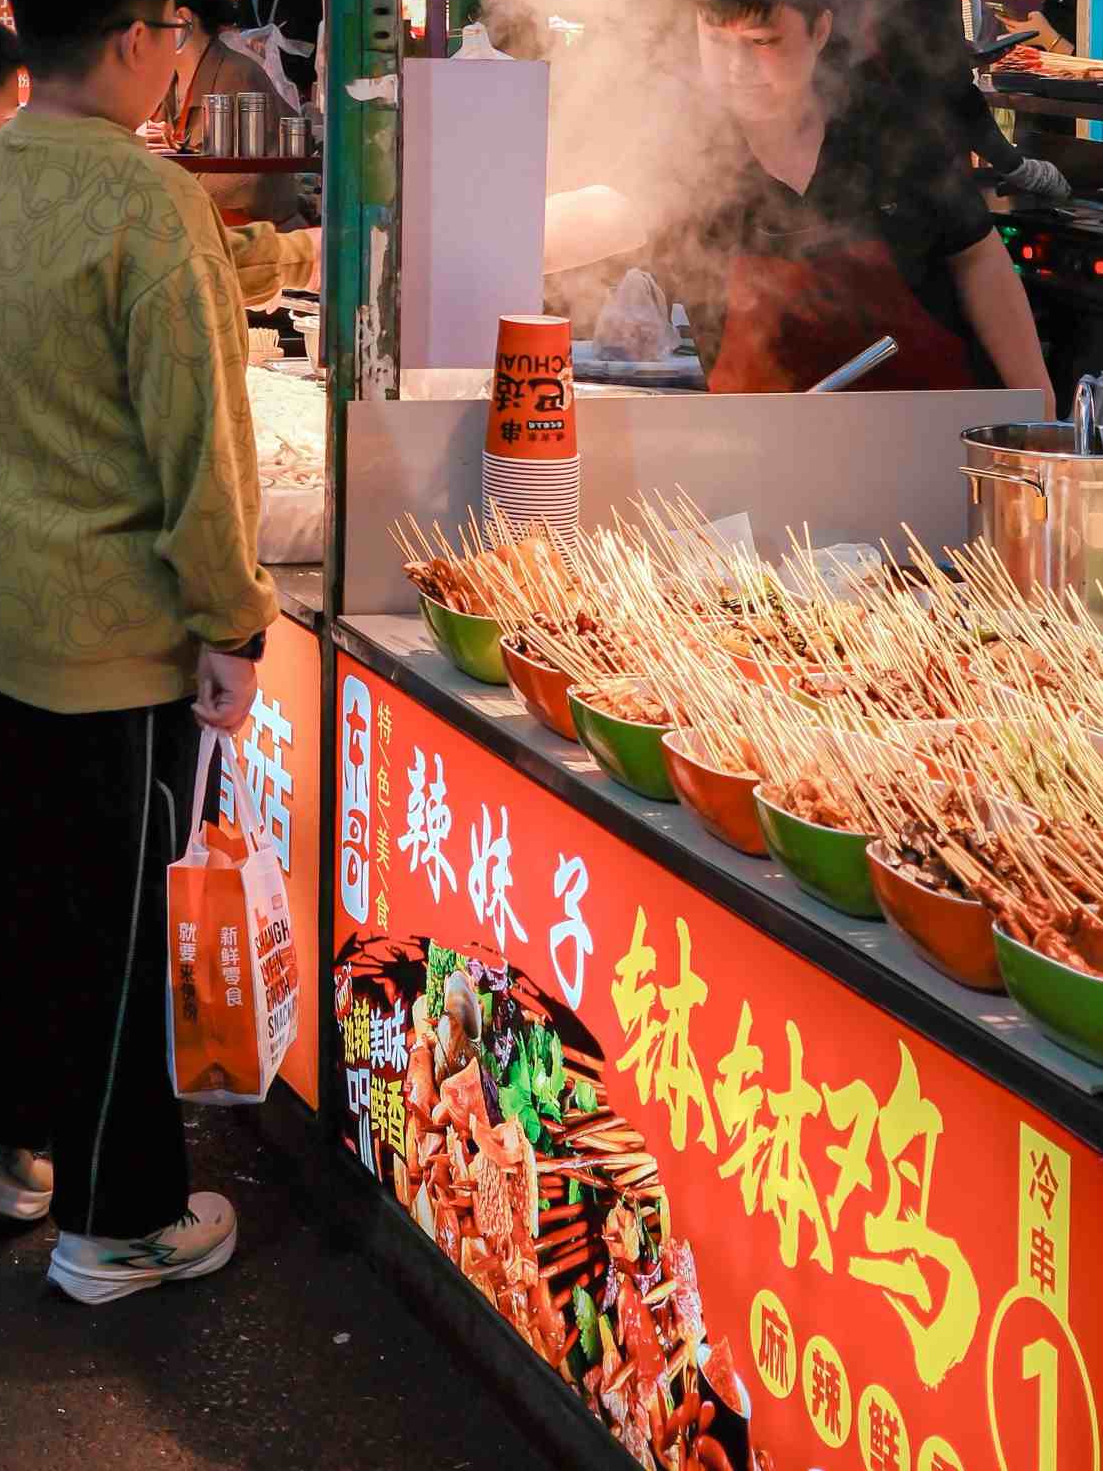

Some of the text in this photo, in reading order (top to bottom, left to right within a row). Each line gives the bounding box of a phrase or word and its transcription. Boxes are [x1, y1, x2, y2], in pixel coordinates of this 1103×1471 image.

[397, 746, 594, 1010] 辣妹子
[220, 926, 245, 1008] 新鲜零食
[1029, 1150, 1060, 1295] 冷串
[759, 1303, 963, 1471] 麻辣鲜
